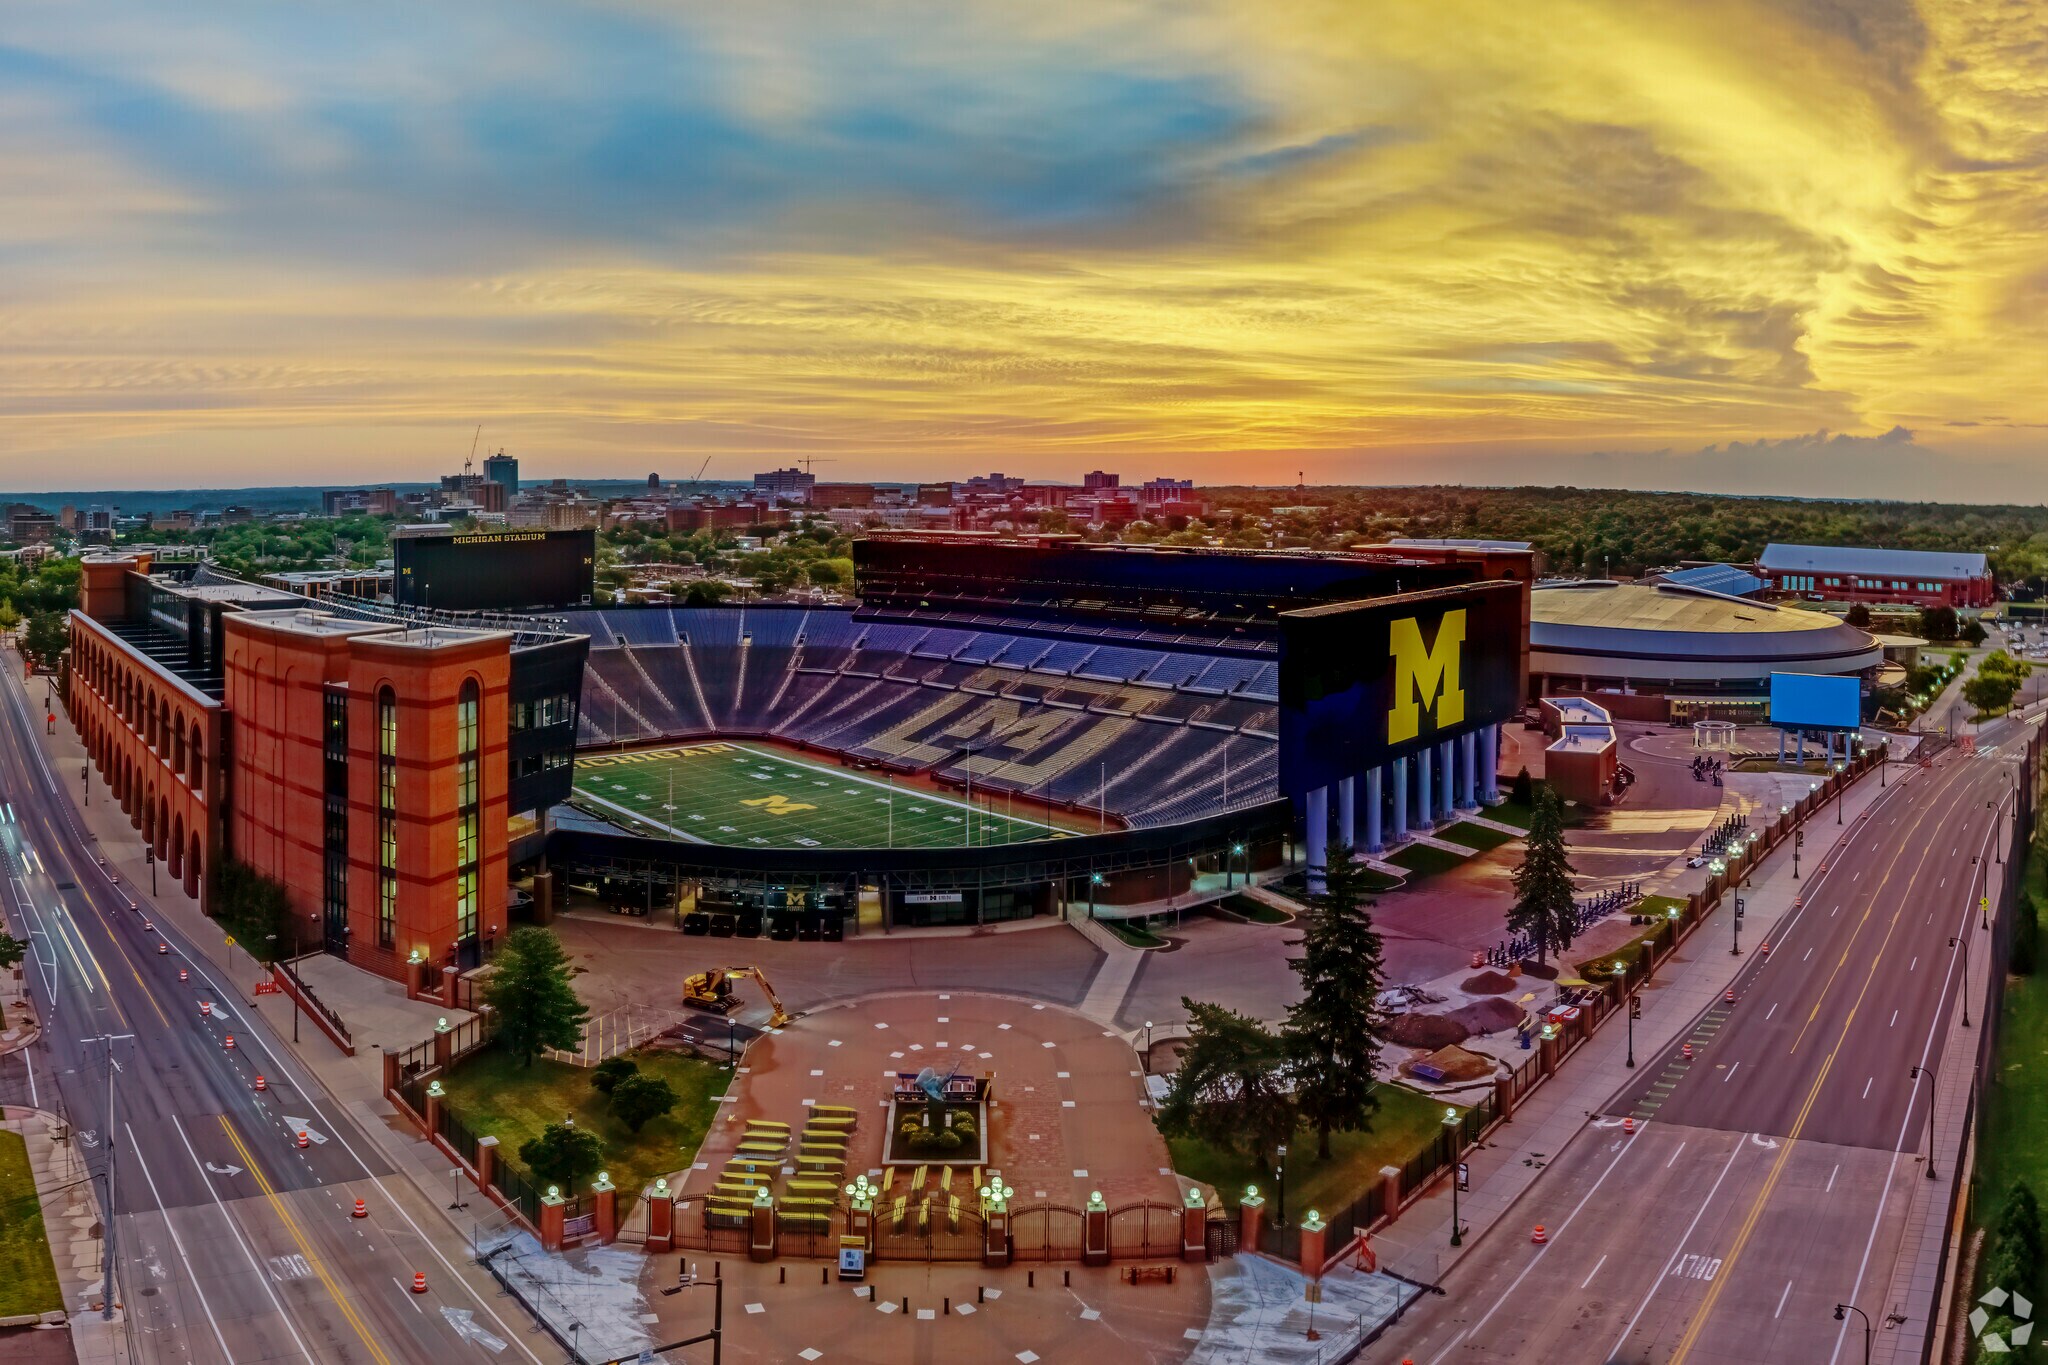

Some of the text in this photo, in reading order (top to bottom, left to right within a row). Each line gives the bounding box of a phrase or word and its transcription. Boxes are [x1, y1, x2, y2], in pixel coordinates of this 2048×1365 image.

[453, 533, 546, 544] MICHIGAN STADIUM
[402, 567, 411, 575] M
[1388, 608, 1466, 745] M
[573, 744, 734, 769] ICHIGAN
[740, 795, 818, 815] M
[786, 892, 805, 905] M
[1670, 1254, 1722, 1280] ONLY
